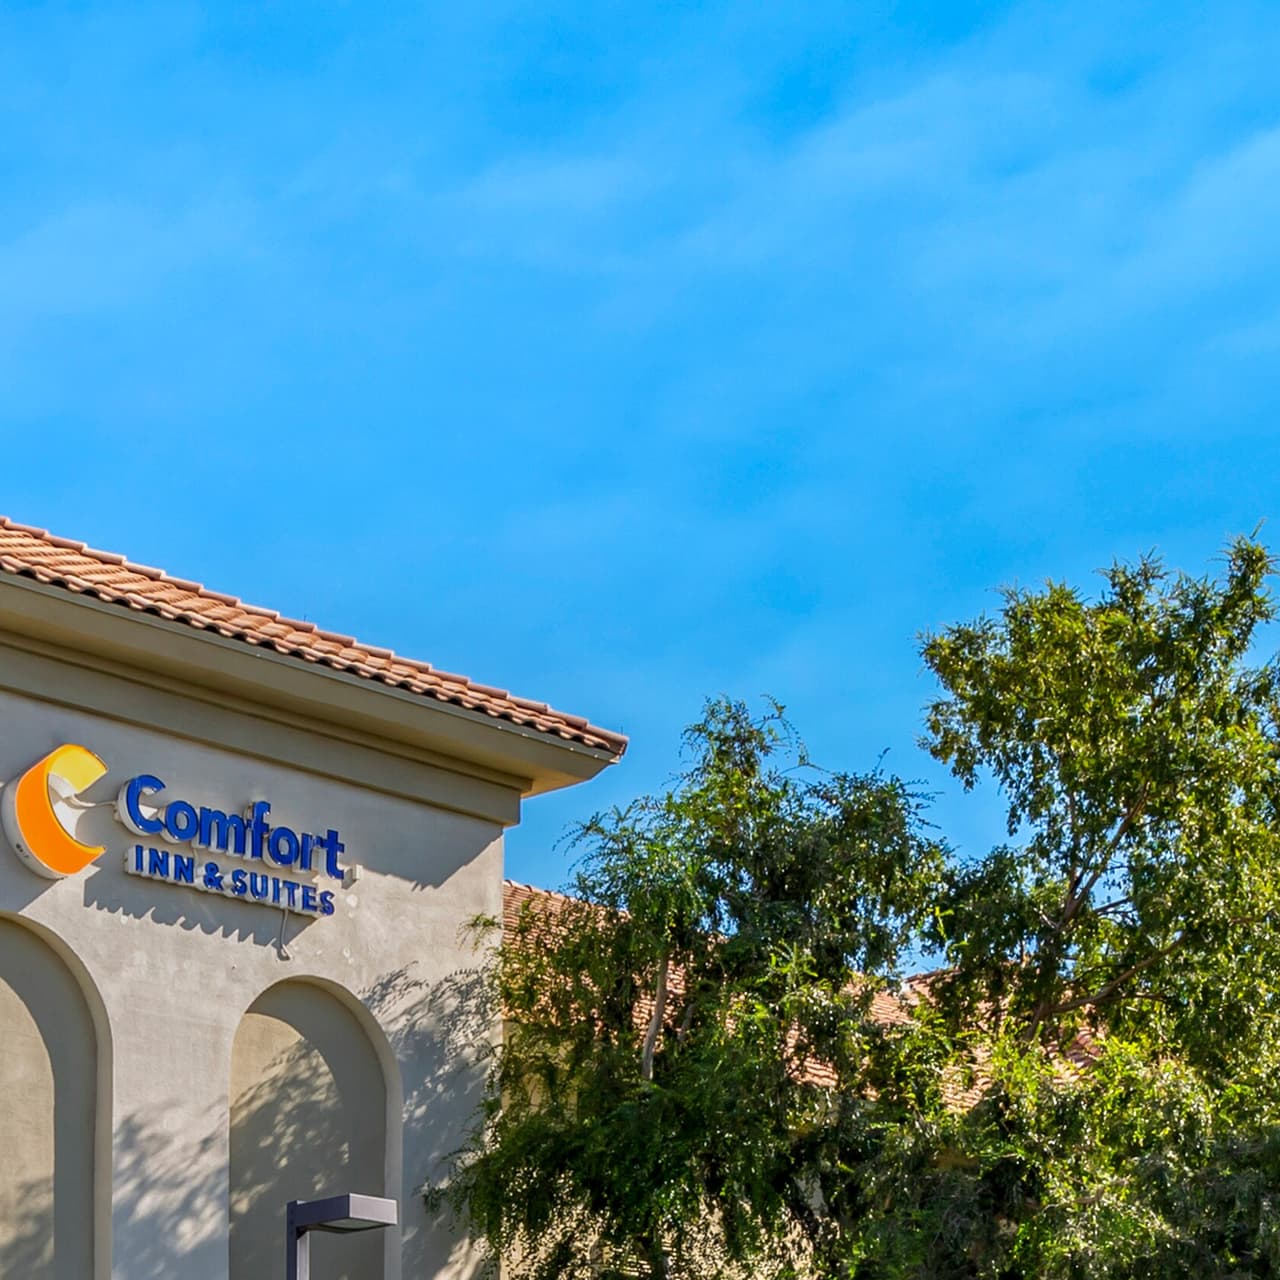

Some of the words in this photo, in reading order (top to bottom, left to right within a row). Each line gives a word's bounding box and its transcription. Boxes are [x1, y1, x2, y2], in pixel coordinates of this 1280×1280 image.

[124, 774, 345, 880] Comfort
[134, 845, 195, 883] INN
[203, 862, 225, 890] &
[231, 869, 335, 916] SUITES
